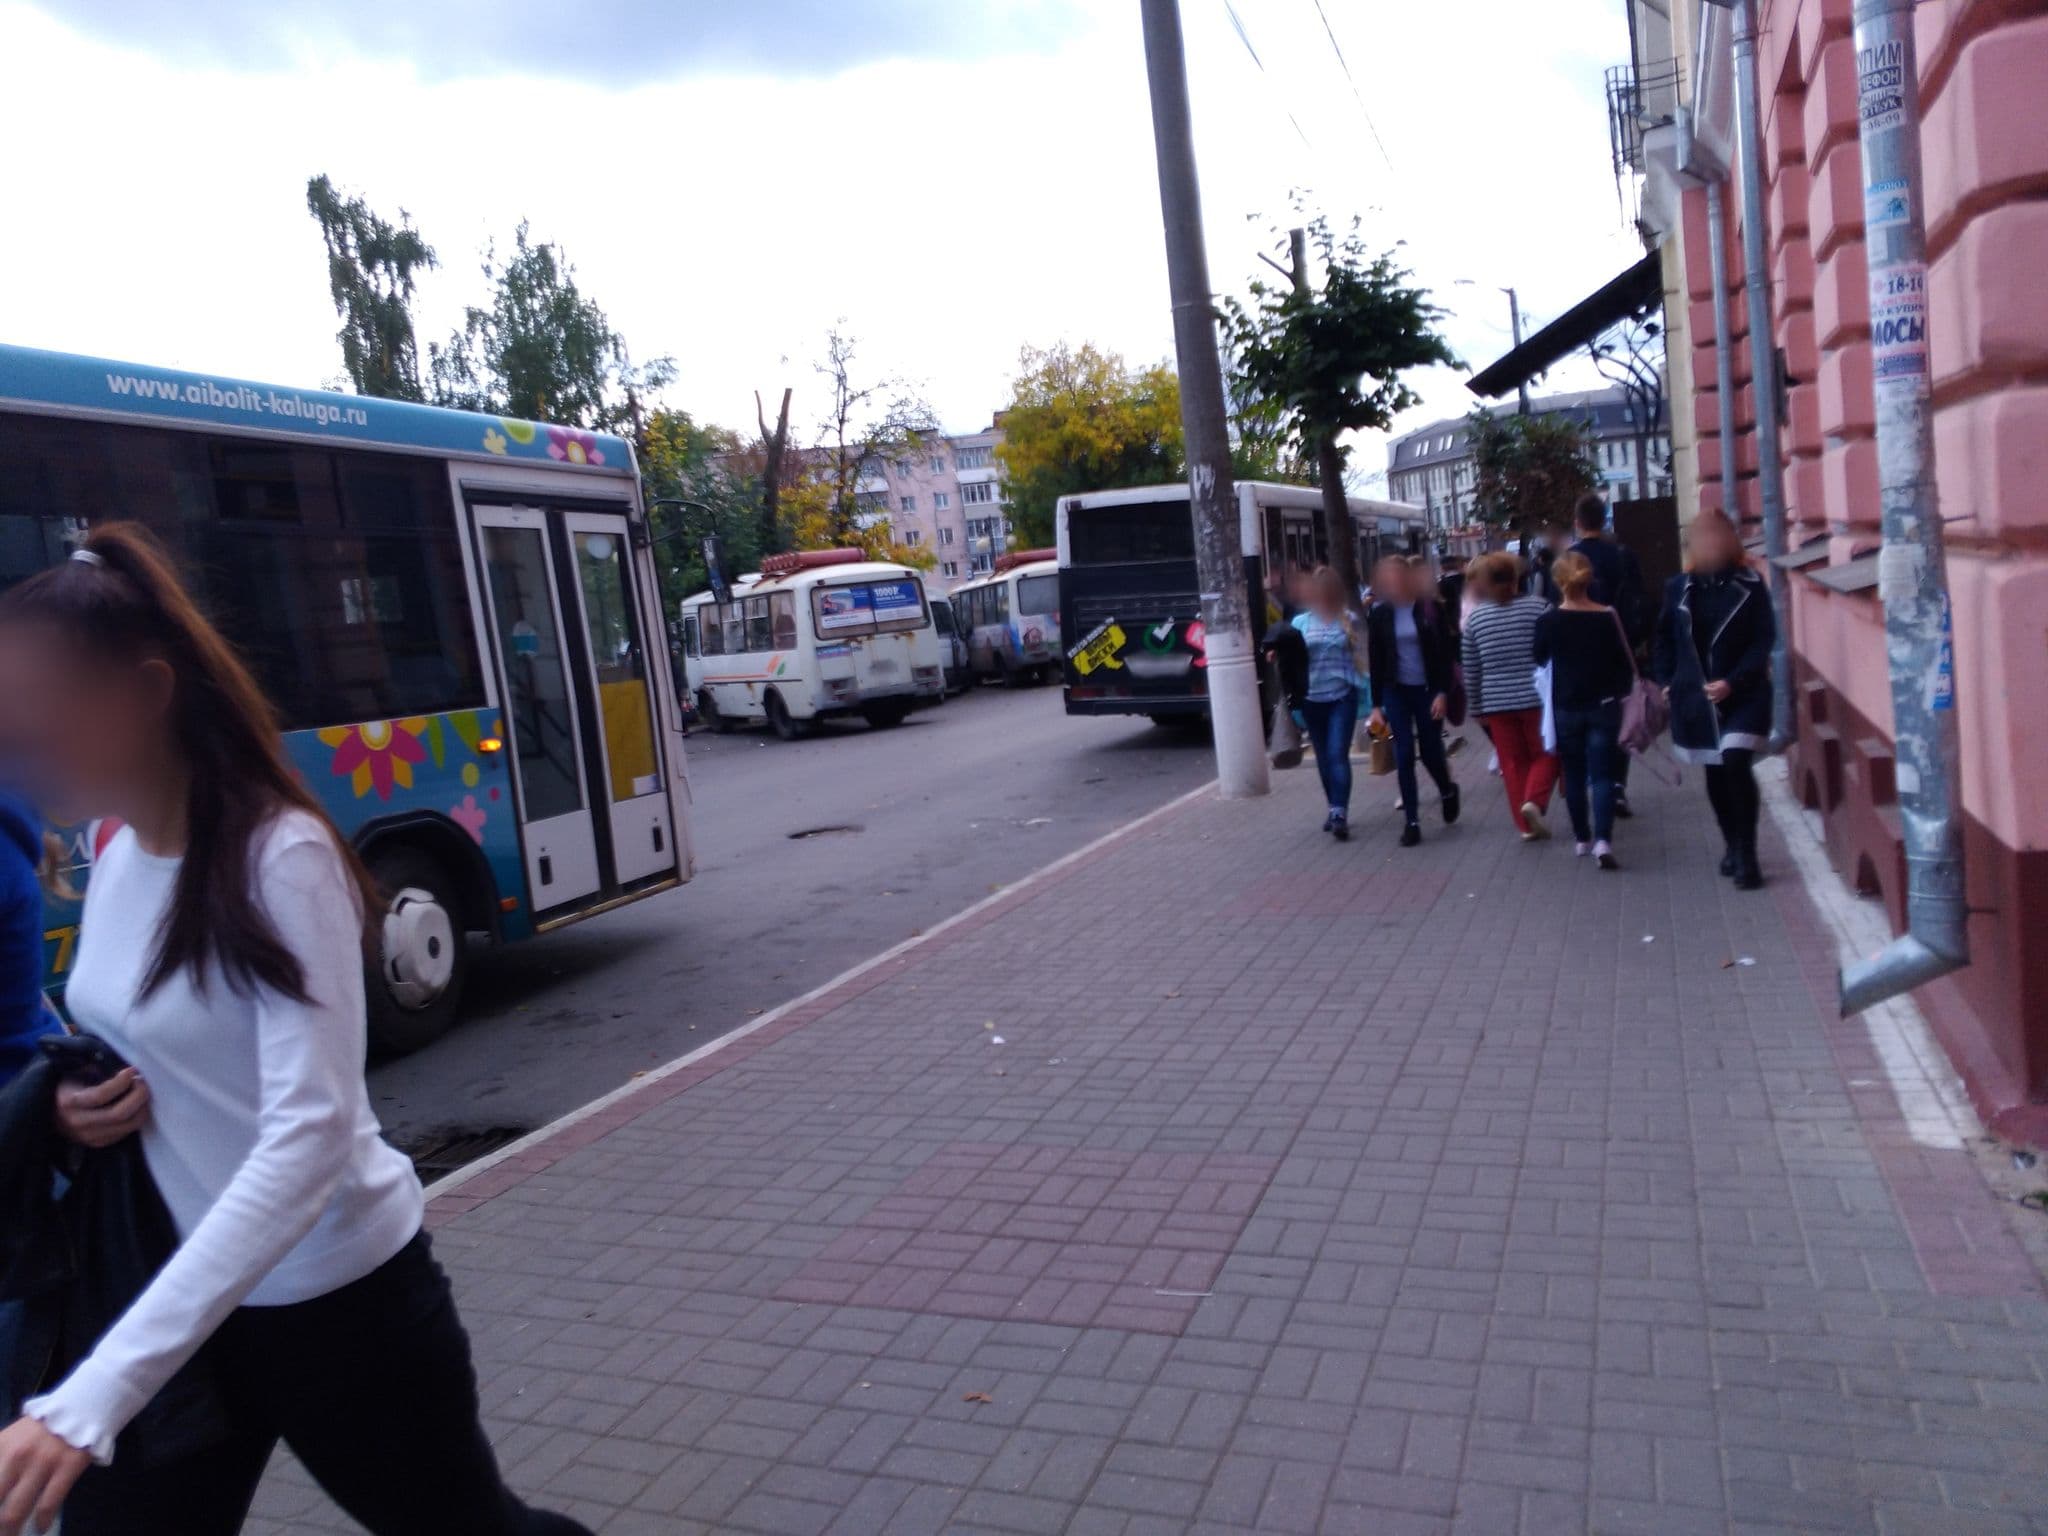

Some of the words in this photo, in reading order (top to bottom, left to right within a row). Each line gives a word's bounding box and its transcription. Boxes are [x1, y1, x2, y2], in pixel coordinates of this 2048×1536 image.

[1858, 42, 1902, 73] УПИМ
[1875, 316, 1925, 346] ЛОСЫ
[106, 373, 368, 426] www.aibolit-kaluga.ru
